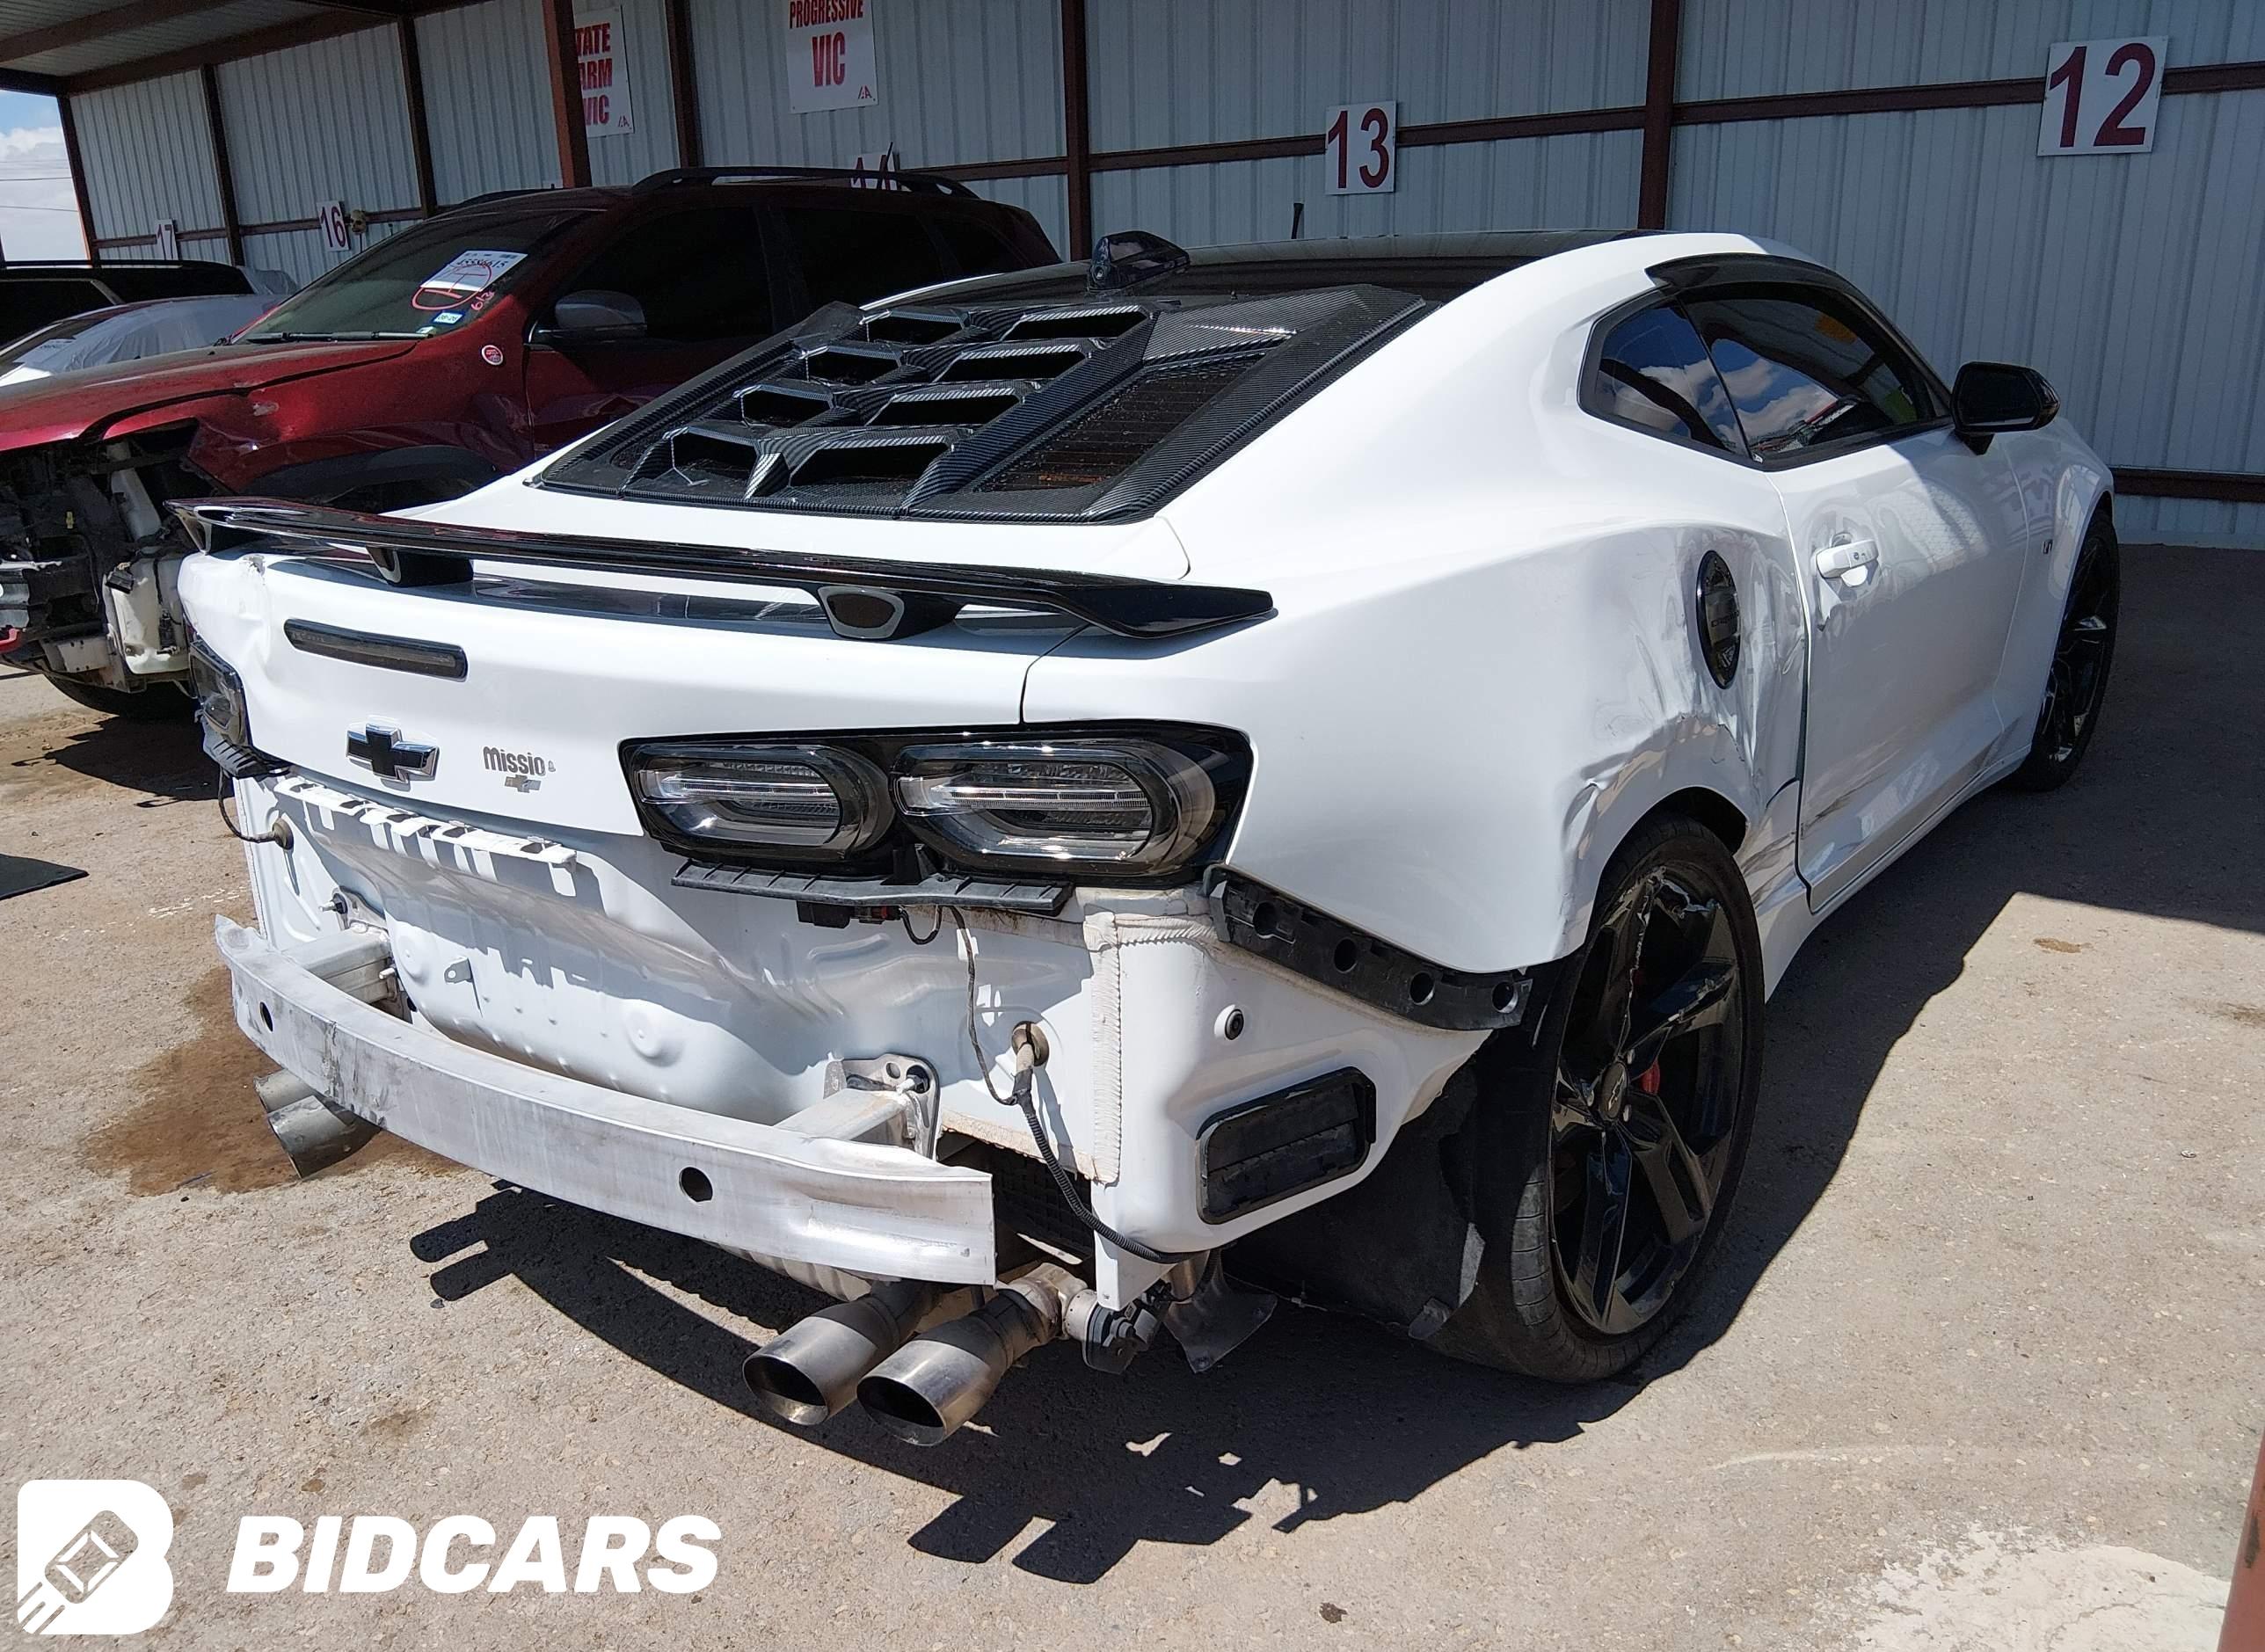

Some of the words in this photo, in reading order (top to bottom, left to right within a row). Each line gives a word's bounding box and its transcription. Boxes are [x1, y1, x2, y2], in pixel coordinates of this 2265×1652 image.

[790, 0, 863, 29] PROGRESSIVE
[575, 23, 610, 55] TATE
[578, 58, 613, 90] ARM
[812, 32, 846, 87] VIC
[2049, 42, 2156, 148] 12
[1328, 107, 1390, 189] 13
[157, 223, 173, 259] 17
[319, 206, 346, 248] 16
